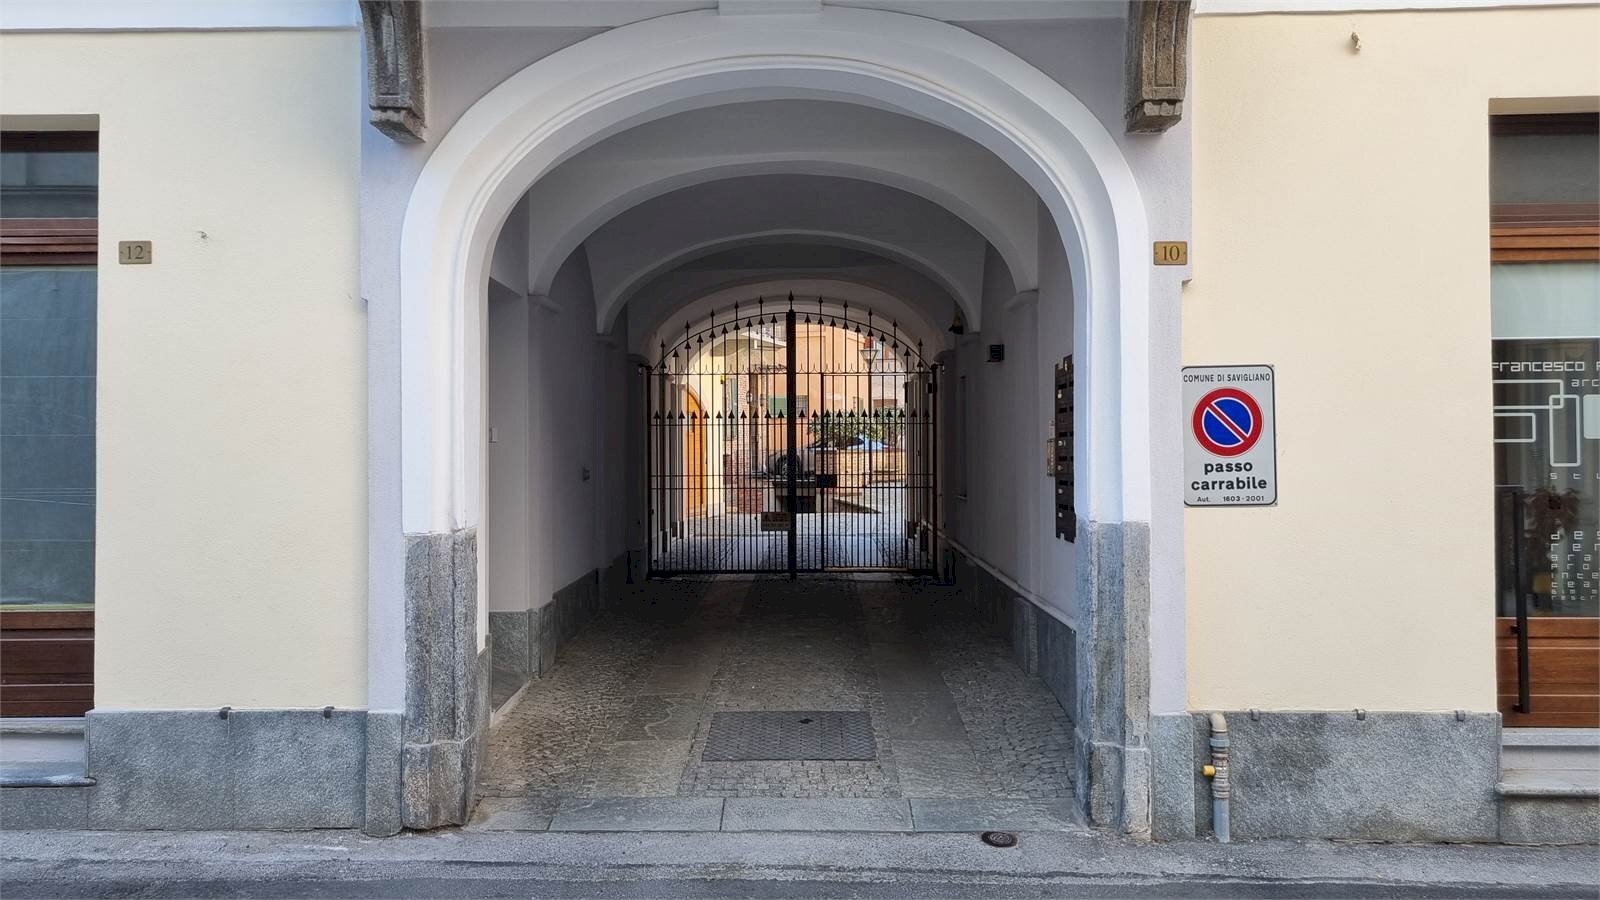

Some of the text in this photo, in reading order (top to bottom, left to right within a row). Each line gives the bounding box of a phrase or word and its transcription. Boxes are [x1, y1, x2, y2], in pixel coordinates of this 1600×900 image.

[127, 245, 144, 260] 12
[1162, 245, 1180, 261] 10
[1183, 372, 1271, 383] COMUNE DI SAVIGLIANO
[1204, 462, 1253, 475] passo
[1191, 477, 1267, 491] carrabile
